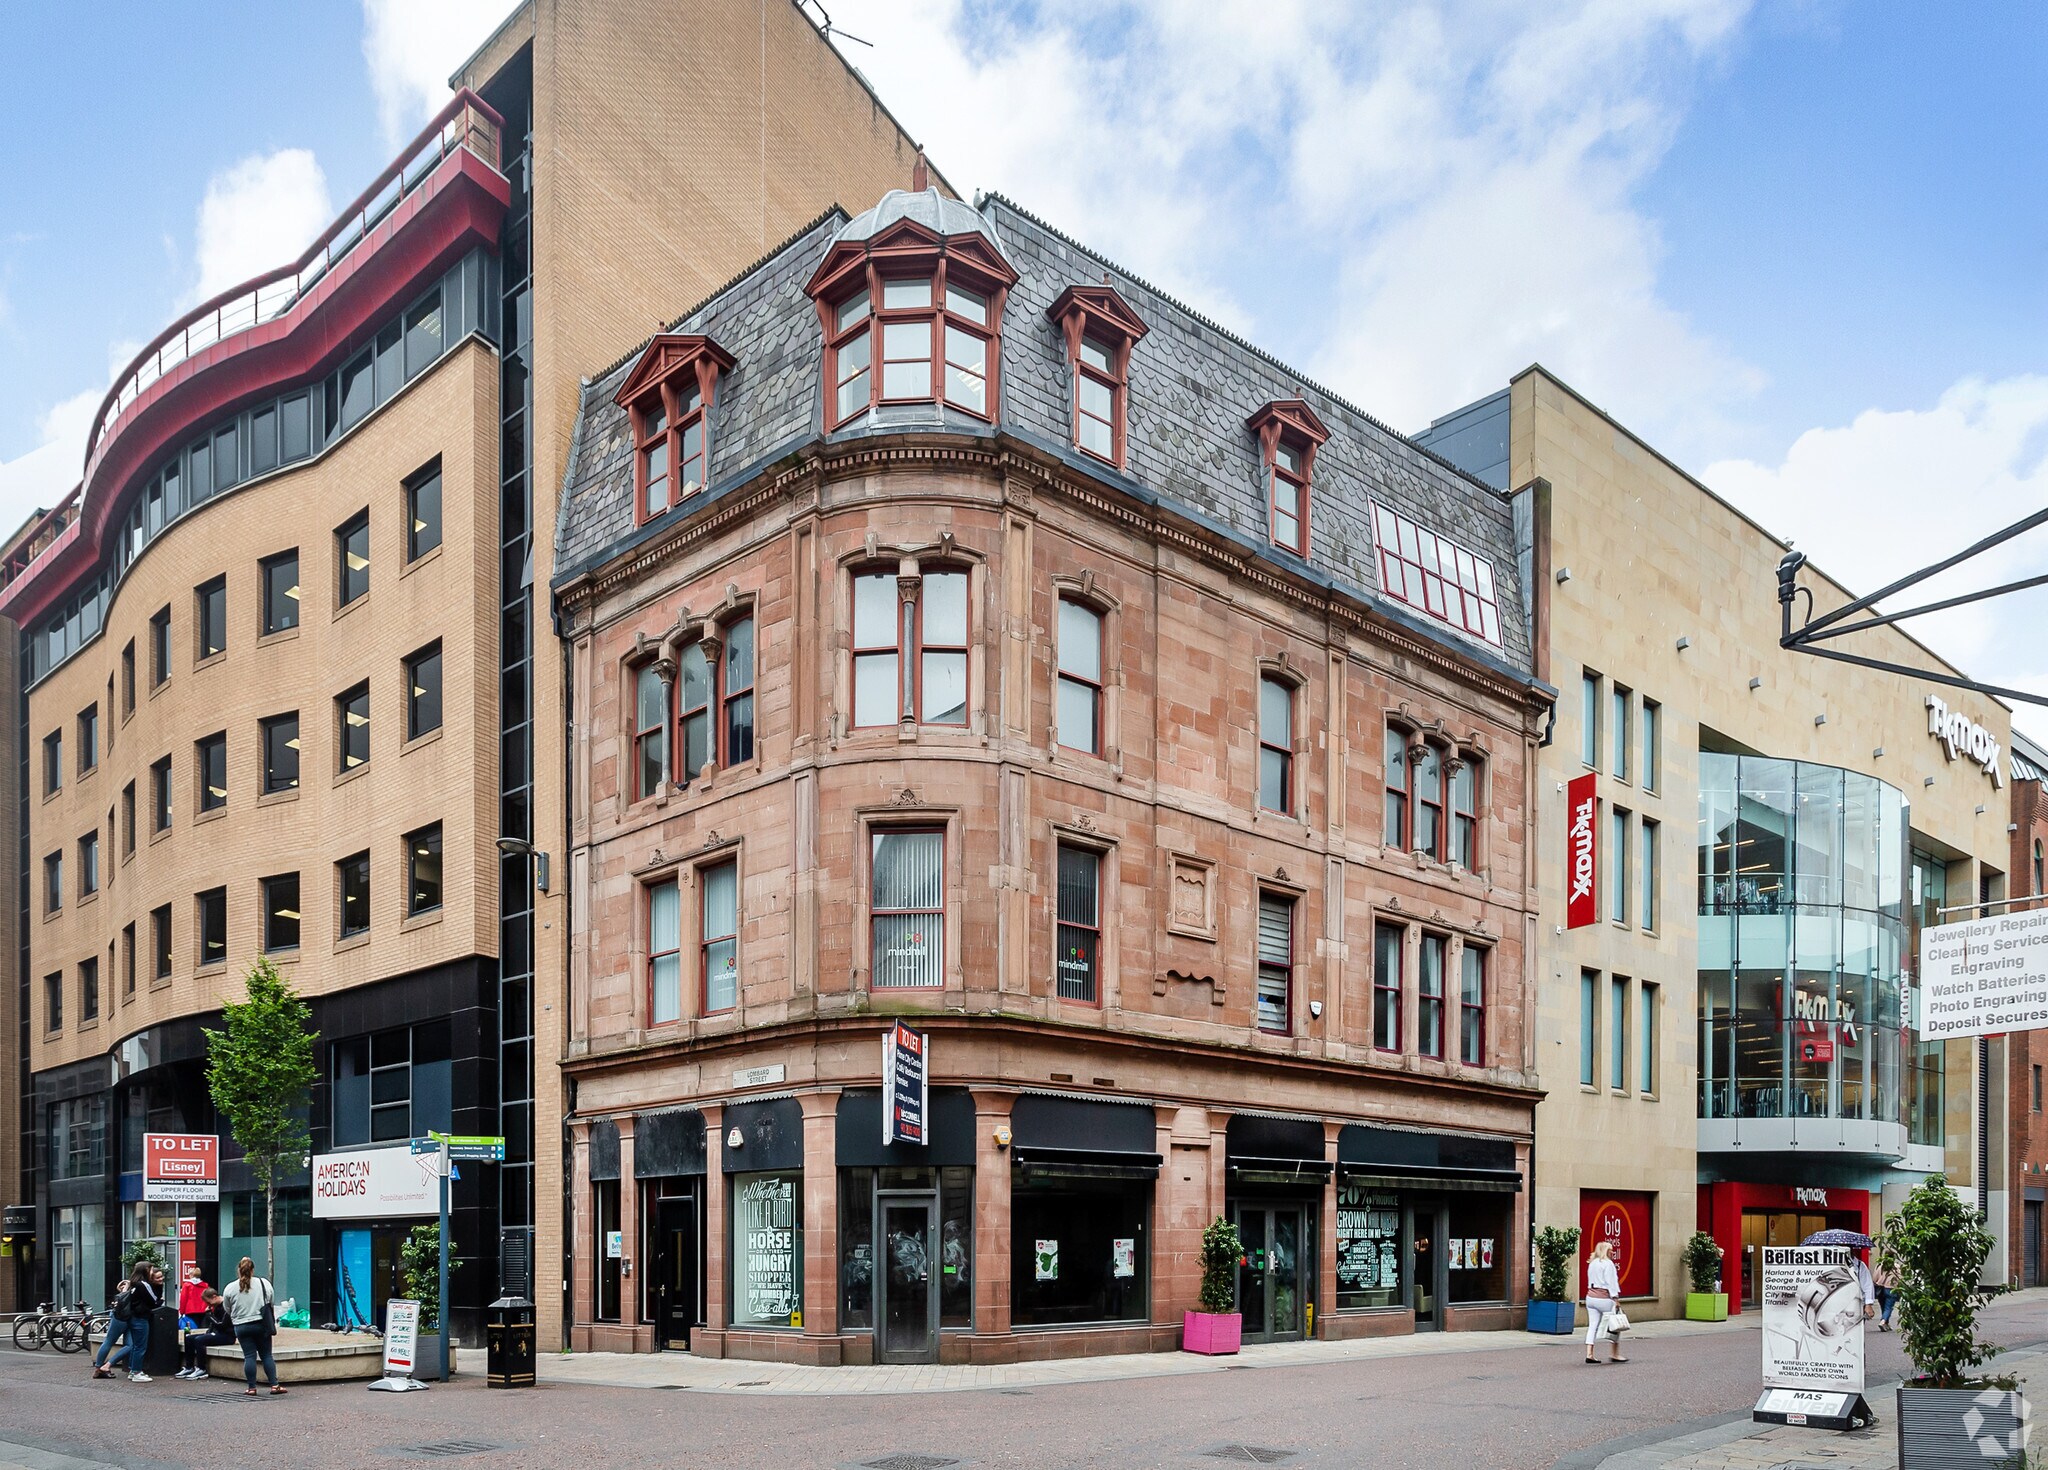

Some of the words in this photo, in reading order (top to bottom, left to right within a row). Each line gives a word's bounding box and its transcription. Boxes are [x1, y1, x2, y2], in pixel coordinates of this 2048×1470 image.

[1930, 924, 1996, 943] Jewellery
[1929, 943, 1989, 961] Cleaning
[1951, 957, 2025, 976] Engraving
[1932, 981, 1973, 997] Watch
[1978, 973, 2046, 991] Batteries
[1930, 1001, 1969, 1014] Photo
[1974, 991, 2047, 1008] Engraving
[1929, 1015, 1981, 1032] Deposit
[1986, 1010, 2048, 1025] Secures
[902, 1029, 910, 1047] TO
[910, 1033, 918, 1052] LET
[747, 1069, 769, 1078] LOMBARD
[152, 1138, 176, 1150] TO
[181, 1139, 212, 1151] LET
[164, 1162, 201, 1173] Lisney
[318, 1161, 370, 1179] AMERICAN
[318, 1179, 366, 1197] HOLIDAYS
[774, 1200, 791, 1227] BIRD
[1337, 1211, 1367, 1228] GROWN
[181, 1225, 190, 1235] TO
[1605, 1215, 1620, 1237] big
[749, 1233, 791, 1248] HORSE
[748, 1254, 792, 1271] HUNGRY
[1765, 1249, 1819, 1264] Belfast
[748, 1272, 791, 1282] SHOPPER
[1793, 1392, 1823, 1401] MAS
[1767, 1399, 1838, 1414] SILVER
